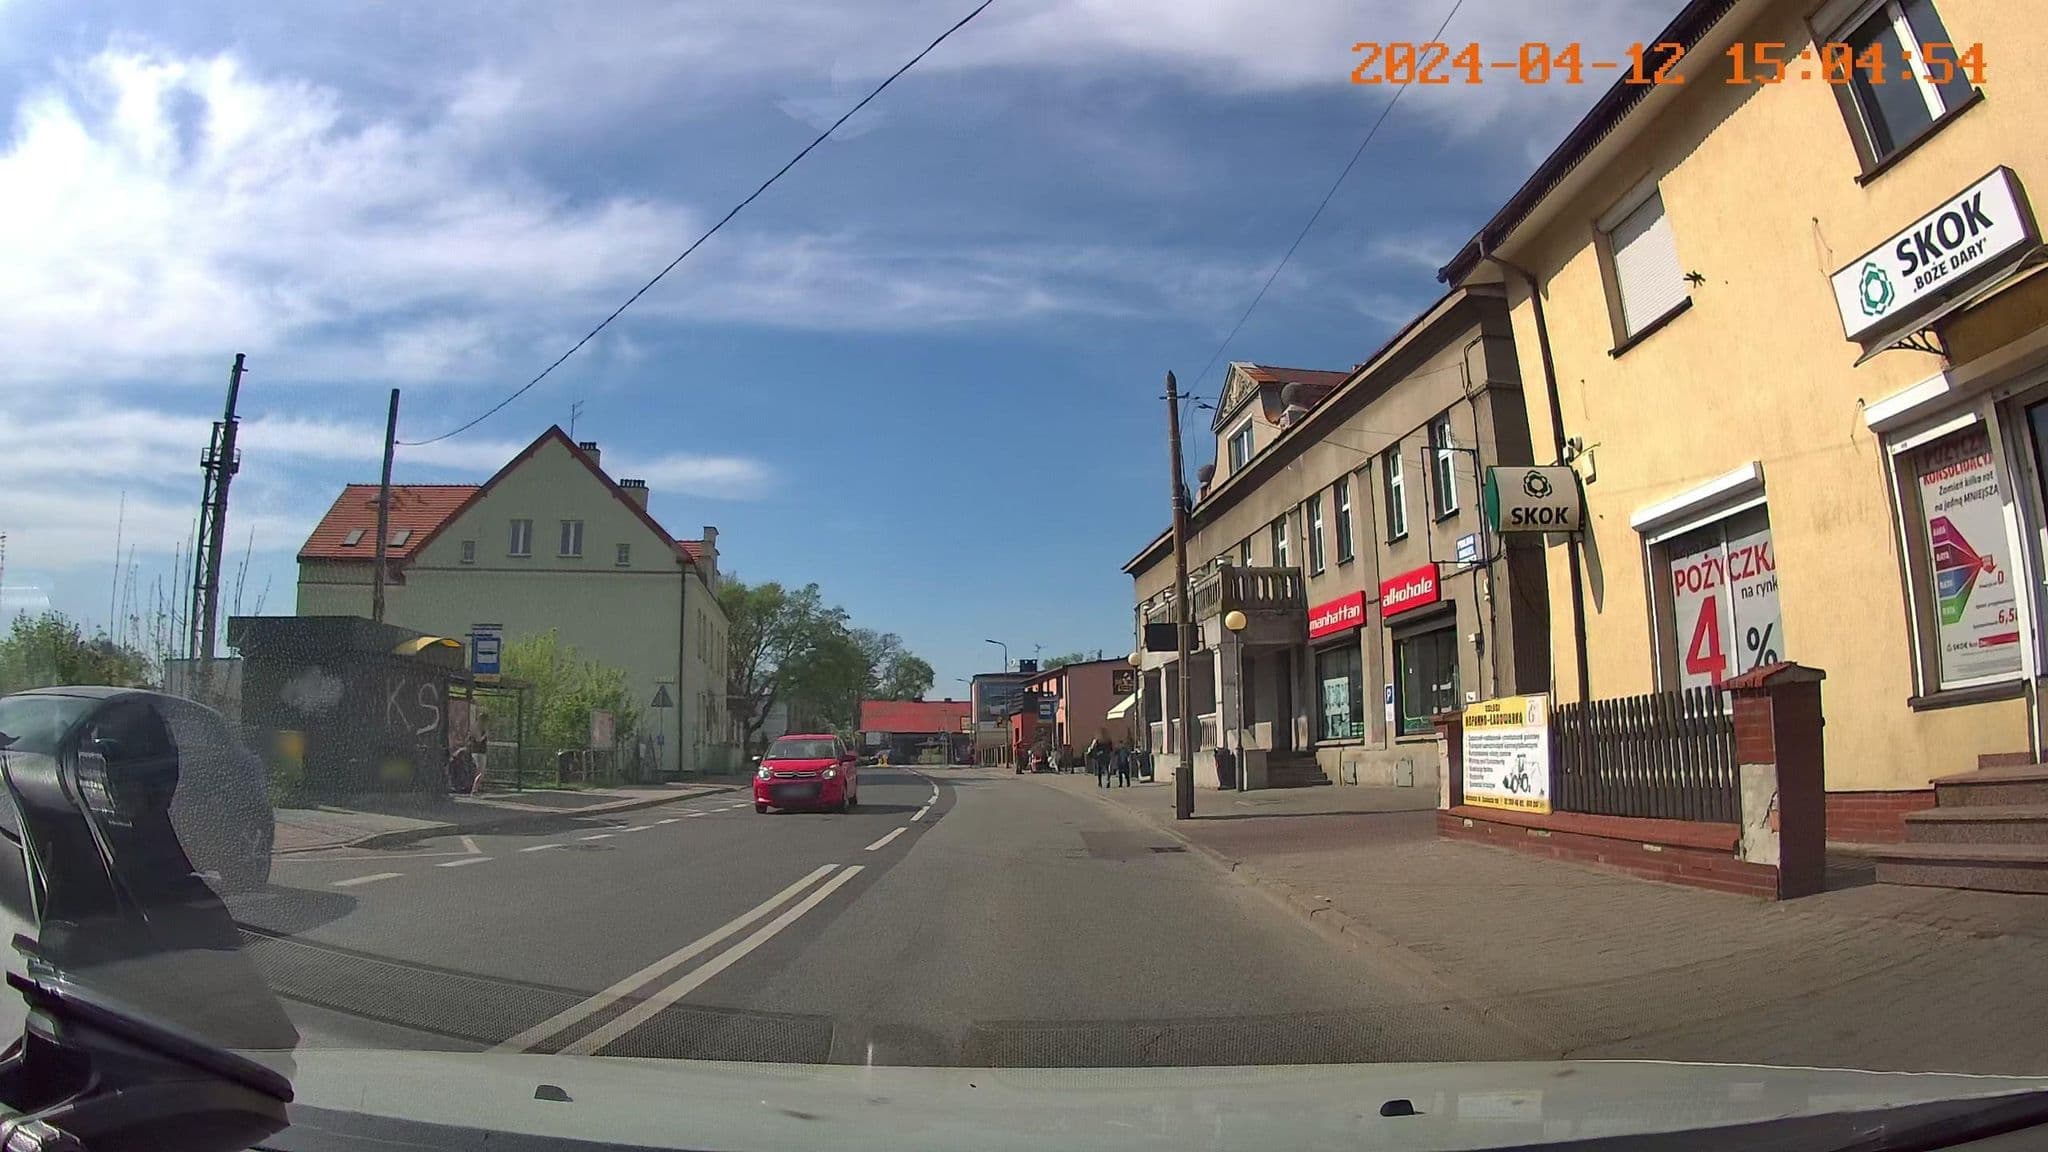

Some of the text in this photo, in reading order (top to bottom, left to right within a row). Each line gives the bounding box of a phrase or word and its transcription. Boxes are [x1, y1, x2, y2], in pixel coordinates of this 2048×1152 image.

[1896, 191, 1994, 277] SKOK
[1511, 507, 1568, 525] SKOK
[1383, 577, 1433, 608] alkohole
[1741, 584, 1754, 599] na
[1309, 603, 1361, 631] manhattan
[1685, 595, 1727, 687] 4
